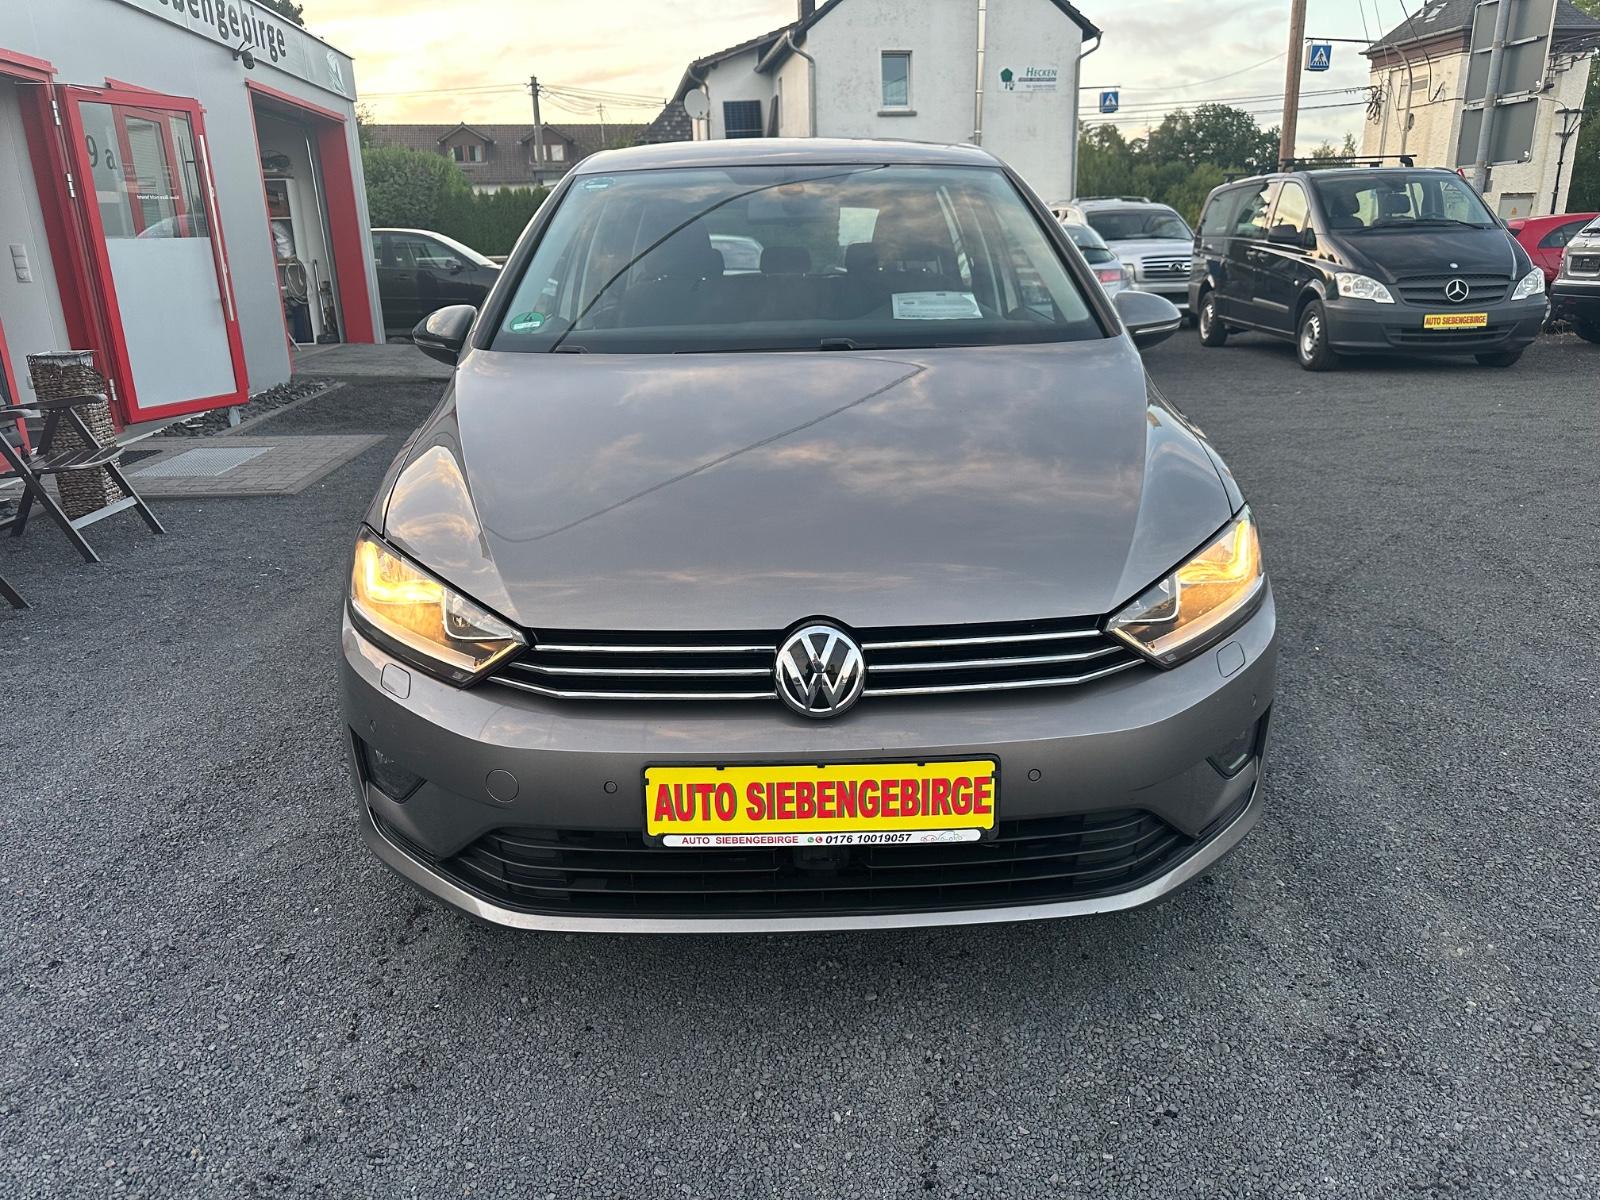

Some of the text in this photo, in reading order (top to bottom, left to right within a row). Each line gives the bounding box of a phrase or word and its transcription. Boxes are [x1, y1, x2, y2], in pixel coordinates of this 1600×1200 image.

[158, 0, 287, 63] engebirge
[85, 134, 117, 170] 9 a
[653, 775, 994, 822] AUTO SIEBENGEBIRGE
[681, 833, 912, 845] AUTO SIEBENGEBIRGE 0176 10019057
